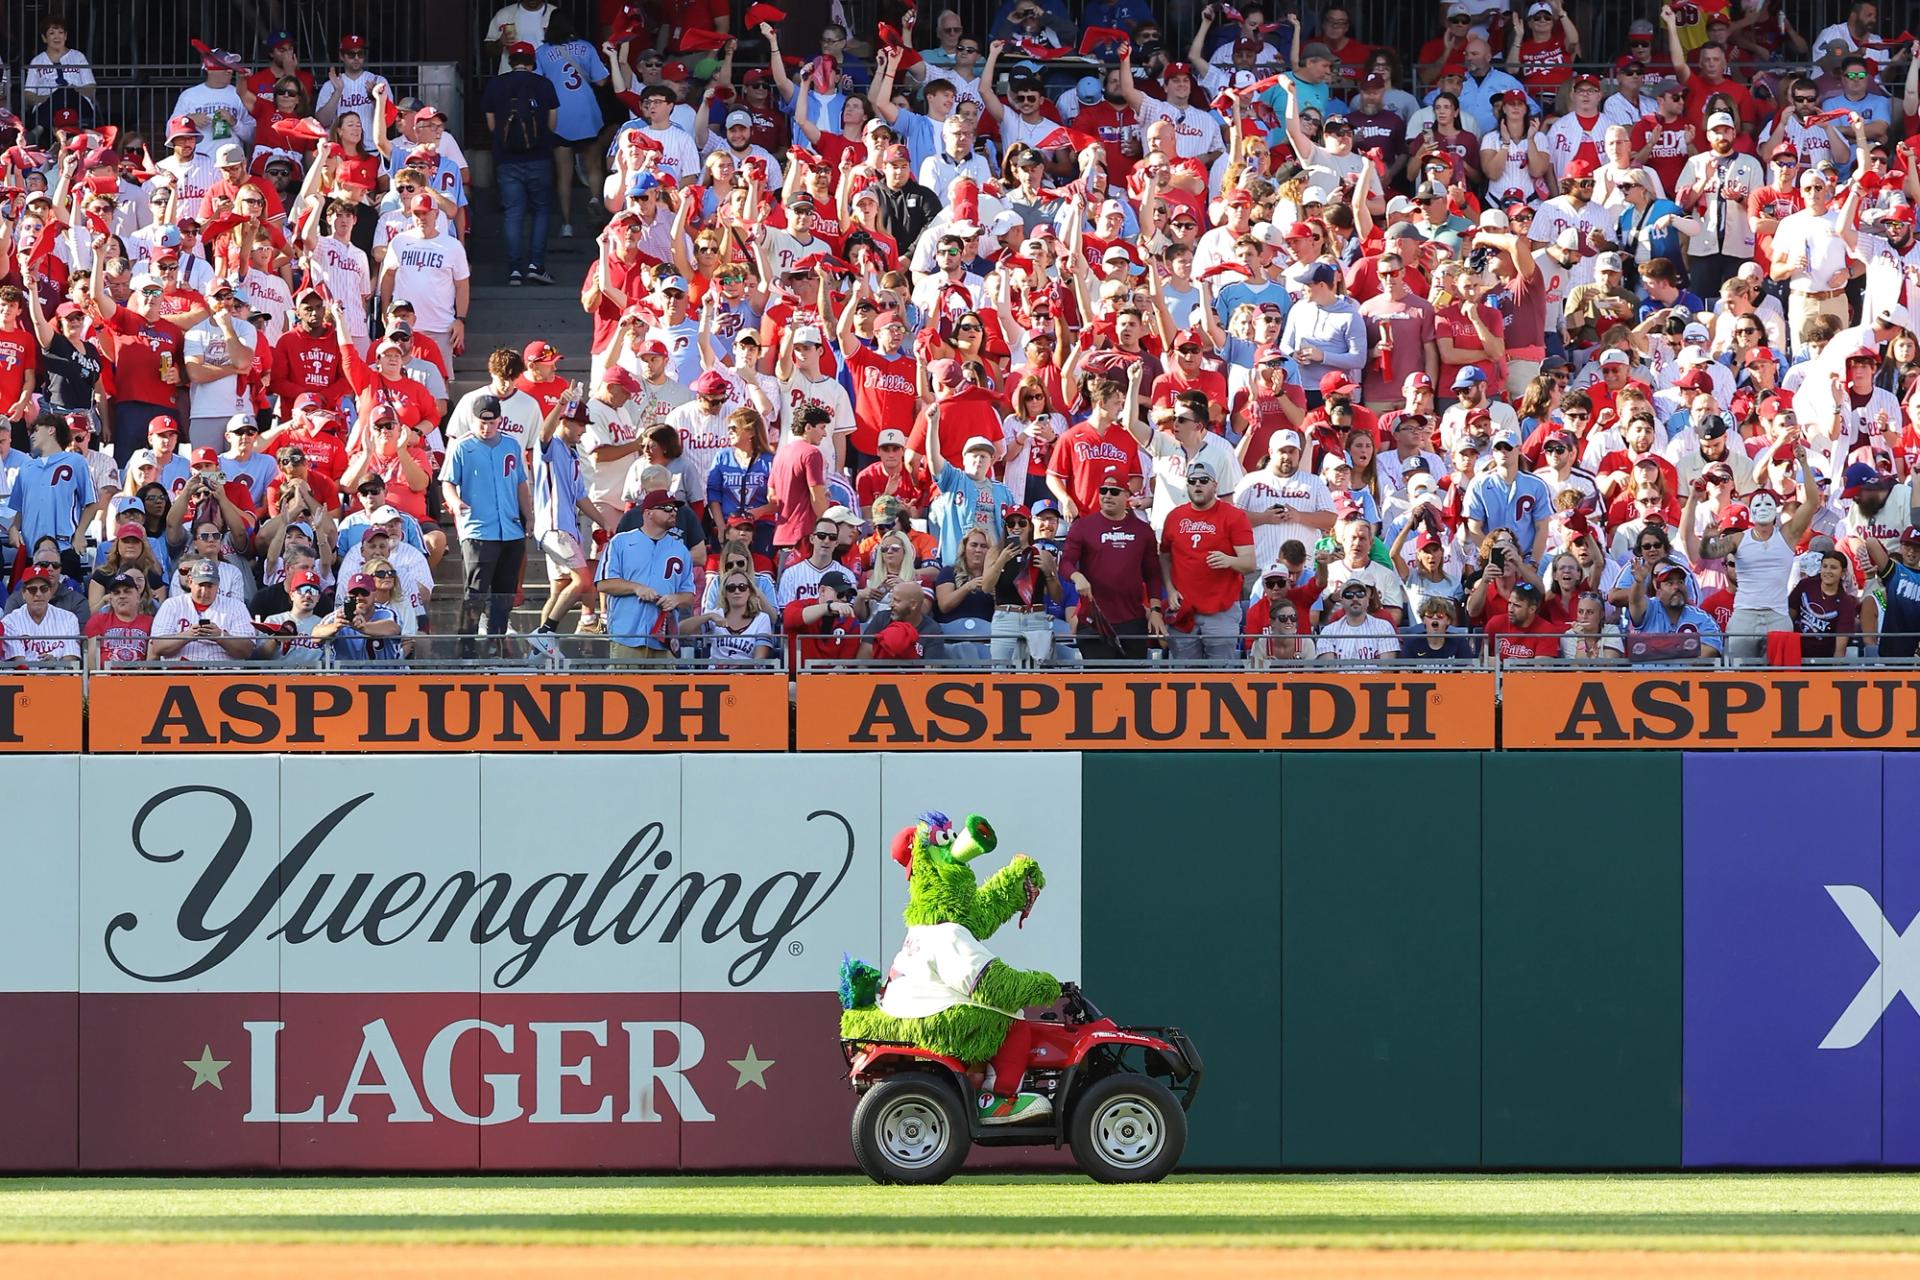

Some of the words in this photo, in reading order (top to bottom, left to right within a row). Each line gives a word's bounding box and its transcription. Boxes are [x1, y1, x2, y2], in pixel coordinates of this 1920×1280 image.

[563, 63, 583, 90] 3
[340, 93, 372, 108] hillie
[441, 172, 455, 191] P
[401, 250, 444, 269] PHILLIES
[150, 340, 159, 351] P
[672, 336, 688, 352] P
[6, 356, 17, 371] P
[313, 360, 322, 374] P
[864, 366, 914, 394] Phillies
[498, 416, 524, 434] llies
[1074, 441, 1128, 463] Phillies
[504, 453, 516, 478] P
[51, 465, 72, 486] P
[1253, 482, 1310, 499] Phillies
[1515, 495, 1535, 521] P
[976, 513, 988, 523] 24
[1179, 518, 1216, 533] Phillies
[1101, 531, 1135, 543] phillies
[1191, 533, 1201, 549] P
[1856, 524, 1900, 541] Phillies
[664, 556, 684, 579] P
[369, 638, 384, 661] P
[716, 638, 753, 654] PHILLIES
[728, 649, 737, 657] P
[1502, 639, 1534, 657] Phillies
[141, 684, 730, 744] ASPLUNDH
[848, 682, 1436, 743] ASPLUNDH
[105, 785, 854, 988] Yuengling
[243, 1018, 716, 1125] LAGER
[980, 1094, 992, 1108] P
